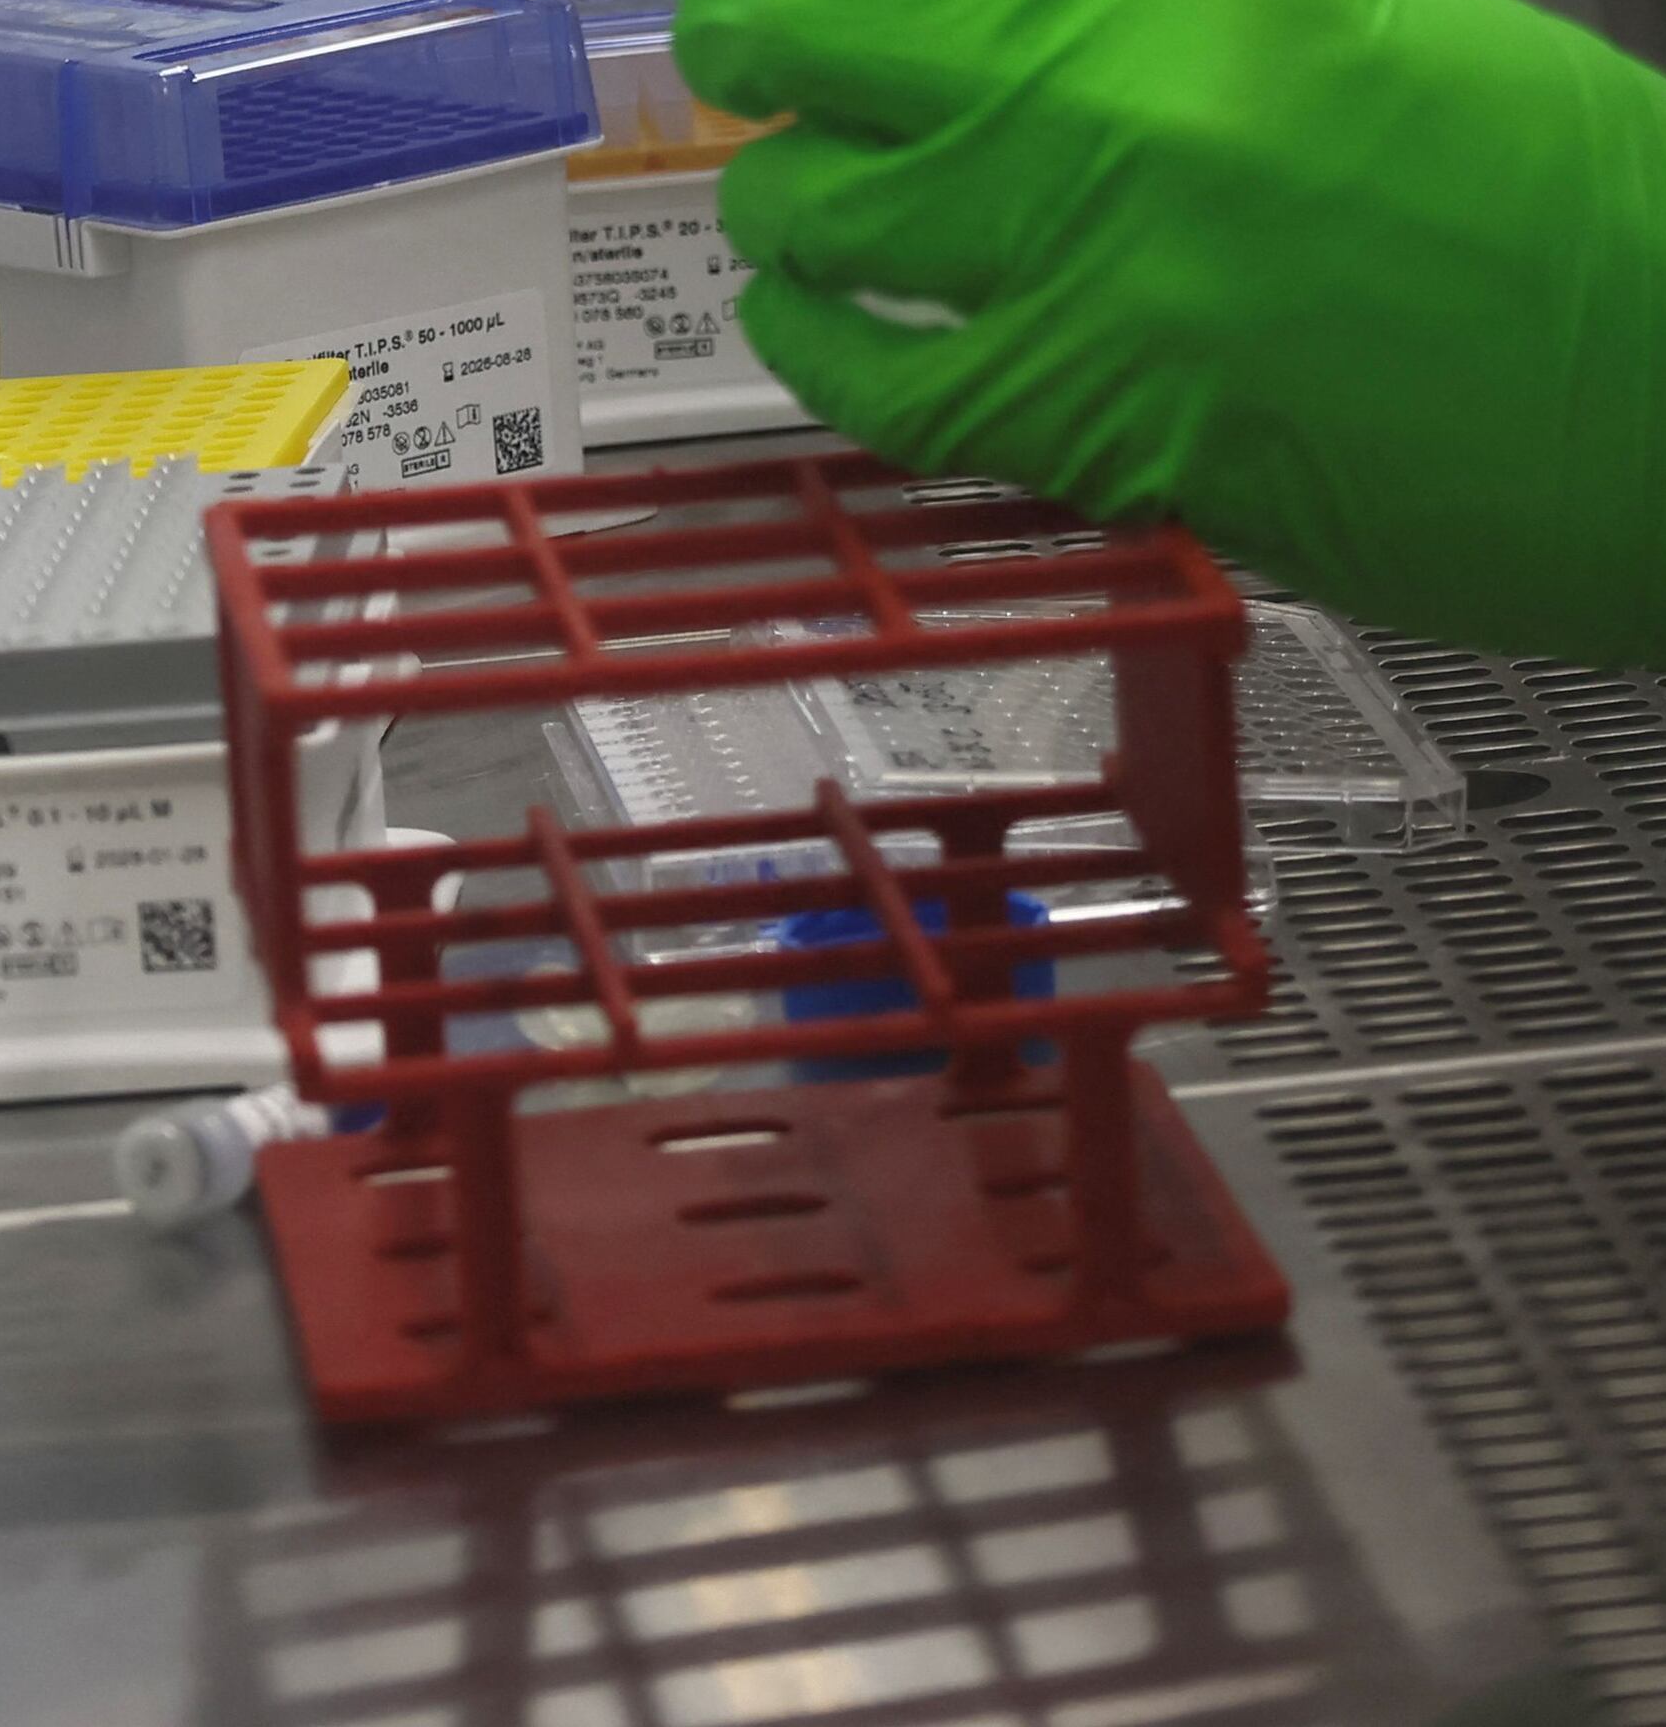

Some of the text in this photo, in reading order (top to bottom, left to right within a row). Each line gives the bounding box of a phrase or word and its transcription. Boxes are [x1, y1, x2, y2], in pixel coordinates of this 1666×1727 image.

[418, 328, 436, 346] 50
[450, 316, 484, 338] 1000
[485, 312, 505, 333] µL
[366, 423, 392, 441] 578
